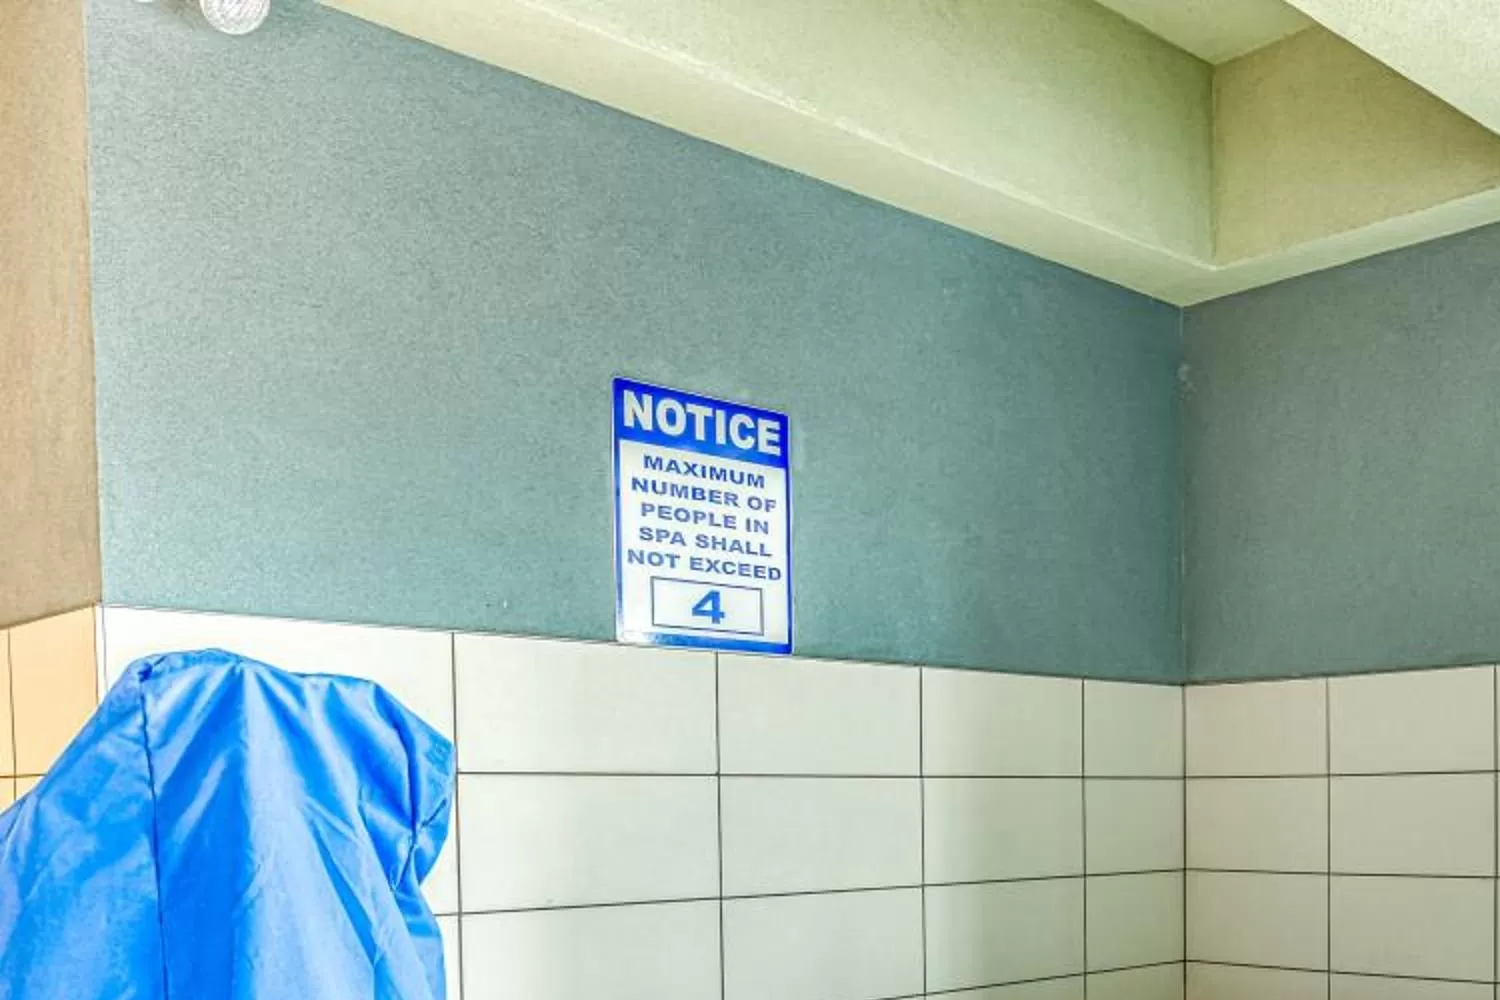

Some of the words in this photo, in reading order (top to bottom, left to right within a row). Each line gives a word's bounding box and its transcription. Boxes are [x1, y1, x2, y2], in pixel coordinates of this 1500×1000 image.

[623, 389, 781, 456] NOTICE
[643, 455, 765, 488] MAXIMUM
[631, 477, 740, 508] NUMBER
[747, 496, 776, 512] OF
[641, 502, 737, 529] PEOPLE
[745, 518, 769, 534] IN
[639, 527, 686, 546] SPA
[695, 534, 772, 557] SHALL
[627, 549, 680, 568] NOT
[690, 556, 781, 580] EXCEED
[692, 589, 725, 624] 4
